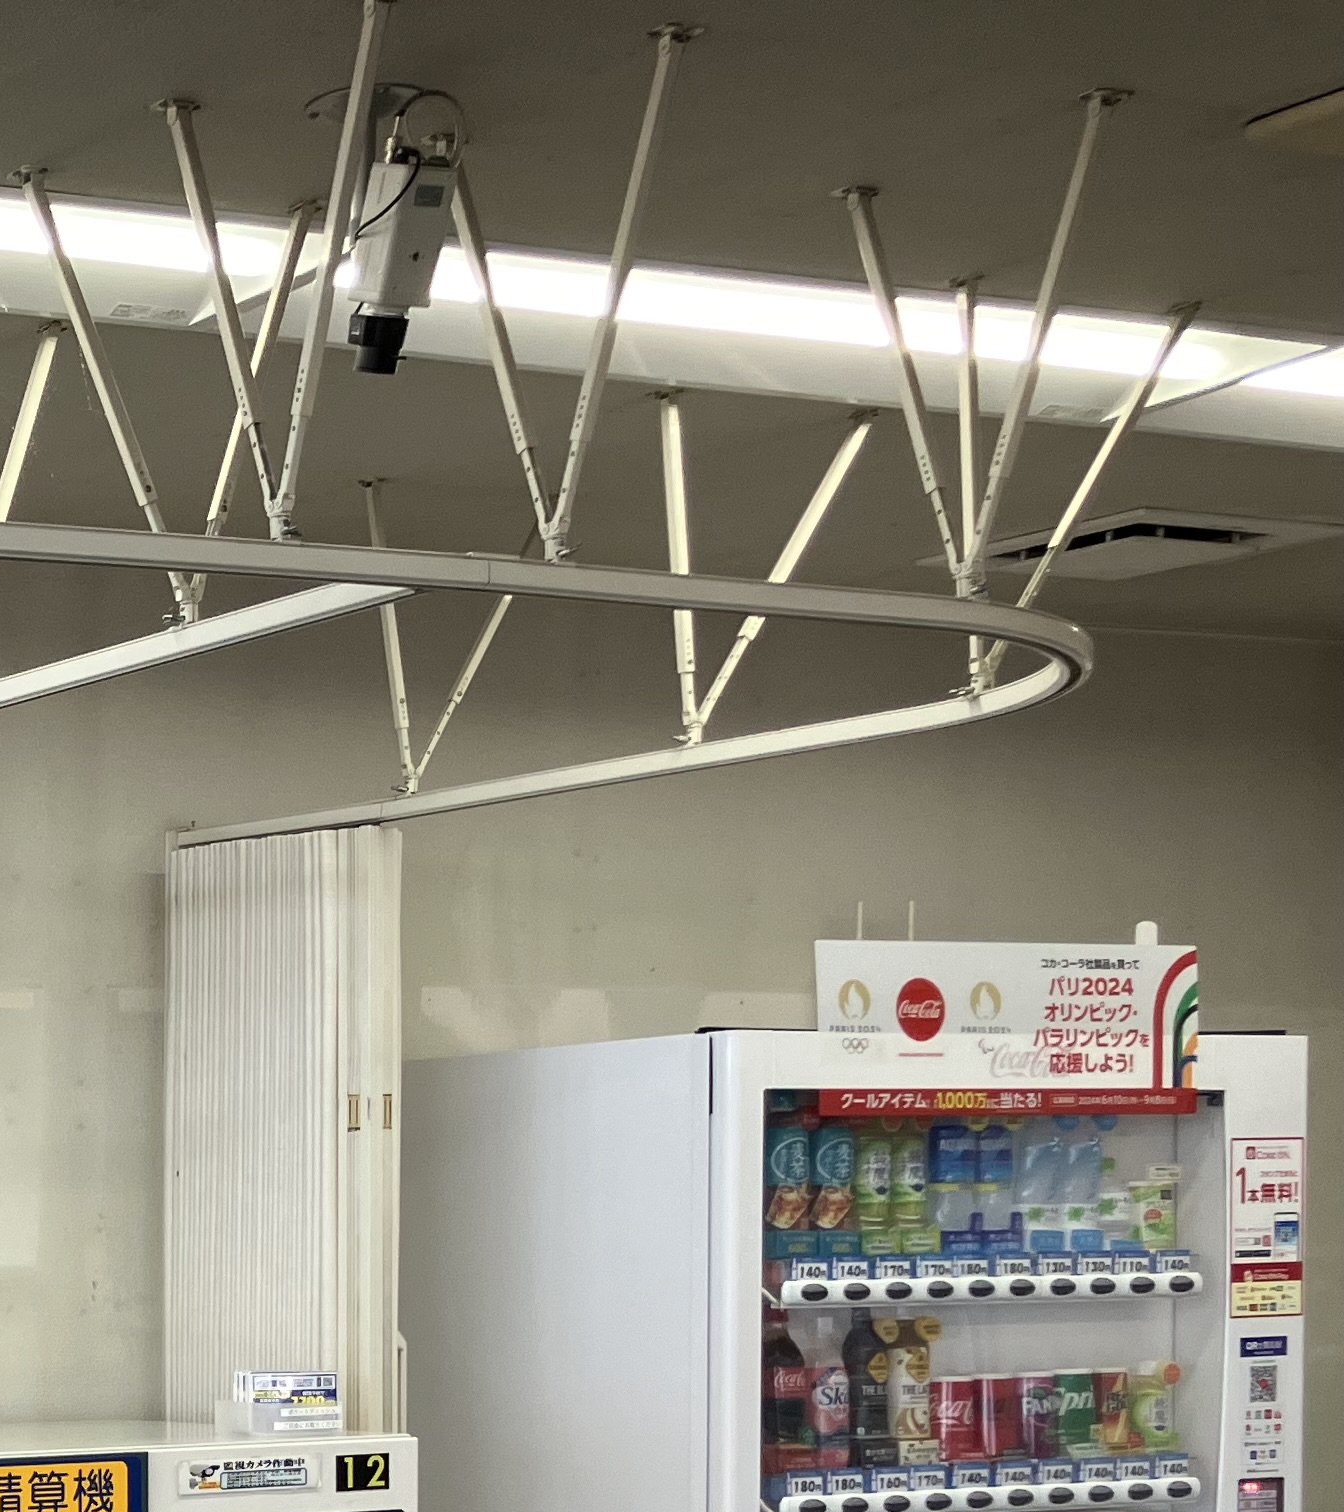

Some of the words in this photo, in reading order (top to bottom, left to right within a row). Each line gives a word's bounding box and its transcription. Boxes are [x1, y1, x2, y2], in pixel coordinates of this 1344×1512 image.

[1048, 976, 1134, 997] パリ2024
[1033, 1028, 1150, 1049] パラリンピックを
[1049, 1053, 1134, 1074] 応援しよう!
[223, 1457, 305, 1470] 監視カメラ作動中
[343, 1455, 386, 1489] 12
